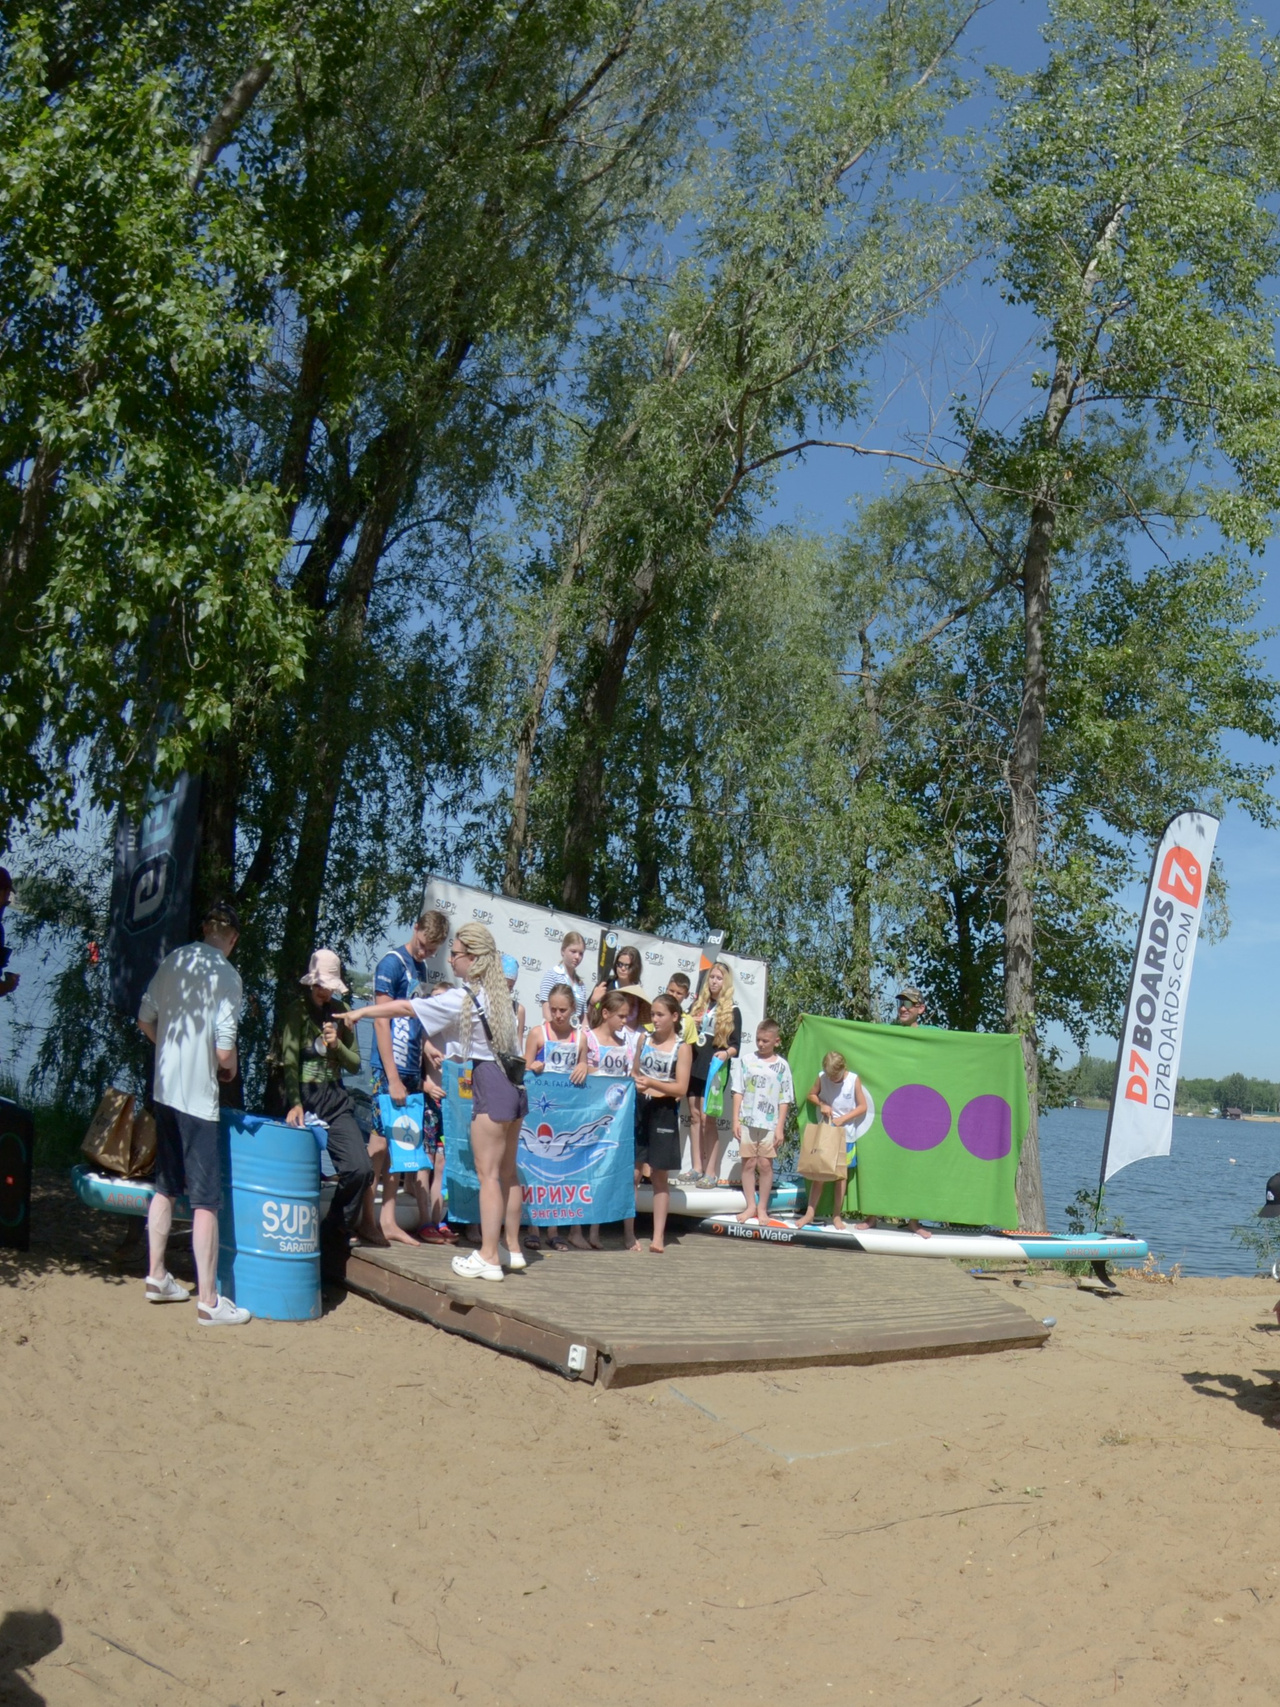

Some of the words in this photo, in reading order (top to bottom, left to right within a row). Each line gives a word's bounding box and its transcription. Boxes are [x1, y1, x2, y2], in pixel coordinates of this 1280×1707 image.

[707, 930, 724, 945] red
[1124, 895, 1174, 1105] D7BOARDS
[1153, 911, 1195, 1111] D7BOARDS.COM
[393, 1014, 411, 1068] RUSS
[644, 1056, 669, 1073] 051
[521, 1184, 593, 1205] ИРИУС
[531, 1208, 584, 1219] ЭНГЕЛЬС
[727, 1224, 793, 1242] HikenWater
[1064, 1247, 1100, 1257] ARROW
